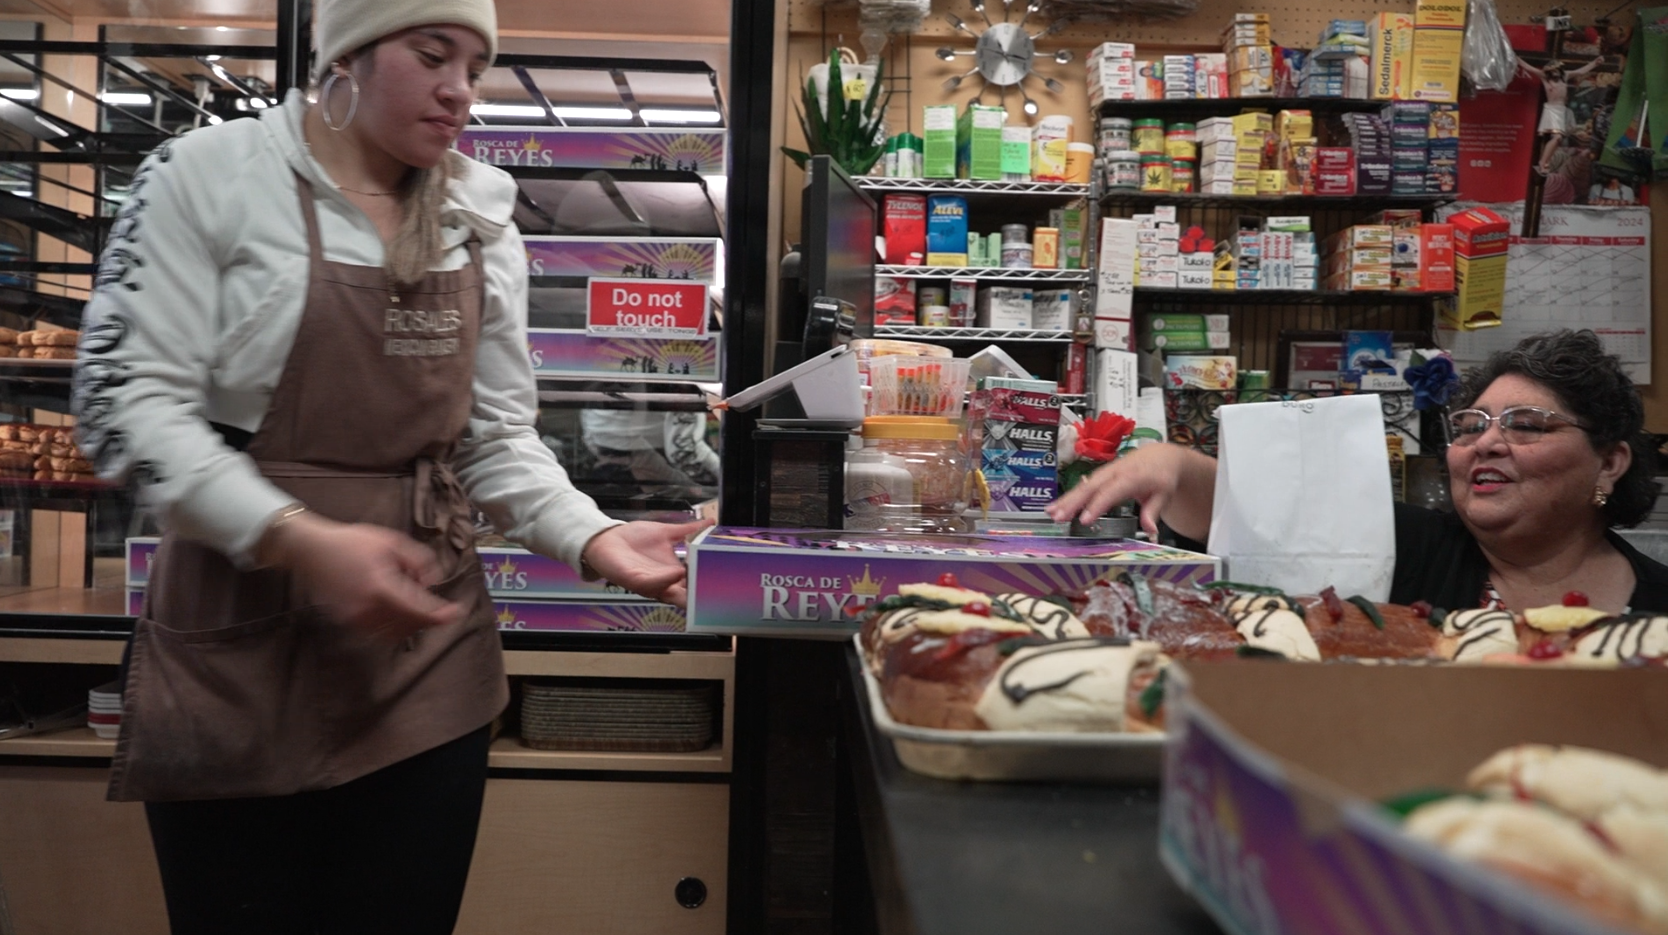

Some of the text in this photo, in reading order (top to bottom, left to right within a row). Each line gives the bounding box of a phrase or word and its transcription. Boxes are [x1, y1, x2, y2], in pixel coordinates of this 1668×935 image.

[1379, 28, 1393, 96] Sedalmerck
[473, 139, 518, 148] ROSCA DE
[474, 147, 553, 167] REYES
[1617, 217, 1644, 227] 2024
[612, 288, 683, 308] Do not
[384, 308, 461, 333] ROSALES
[616, 308, 676, 328] touch
[1012, 396, 1047, 408] HALLS
[1009, 428, 1053, 442] HALLS
[1007, 457, 1042, 468] HALLS
[1009, 487, 1053, 499] HALLS
[484, 572, 528, 590] YES
[760, 573, 842, 589] ROSCA DE
